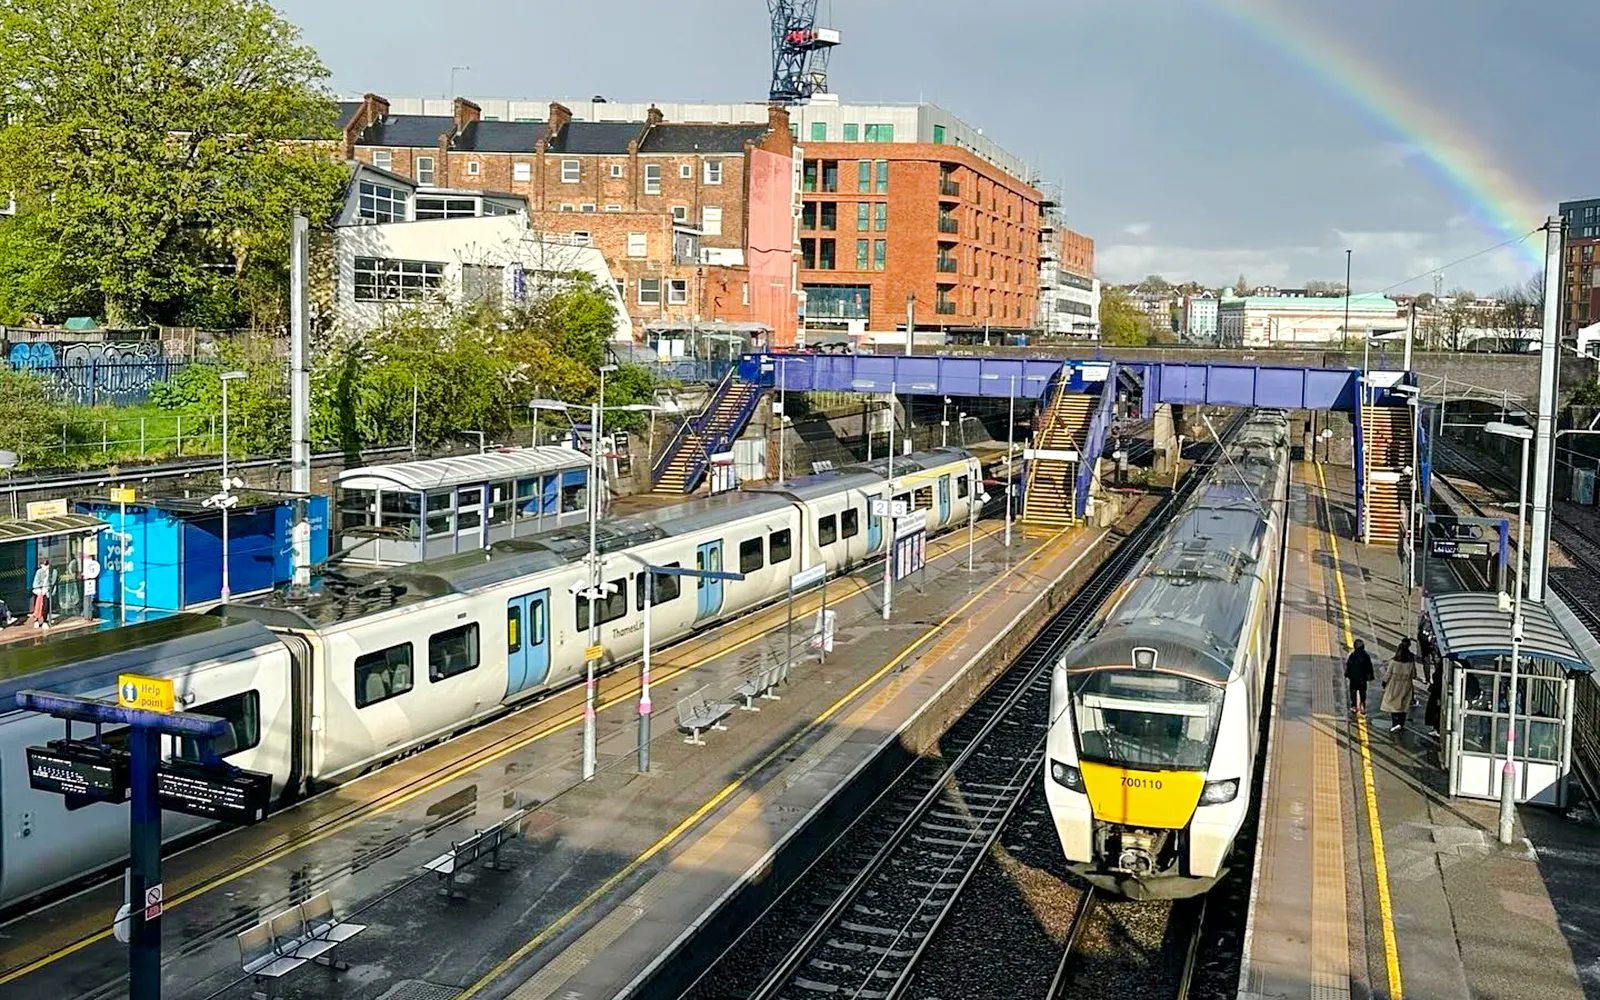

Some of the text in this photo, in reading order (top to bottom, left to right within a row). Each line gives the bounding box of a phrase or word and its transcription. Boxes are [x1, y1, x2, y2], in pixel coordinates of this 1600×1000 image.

[876, 502, 884, 514] 2
[895, 503, 903, 515] 3
[141, 684, 161, 697] Help
[141, 698, 164, 709] point
[1120, 777, 1162, 789] 700110
